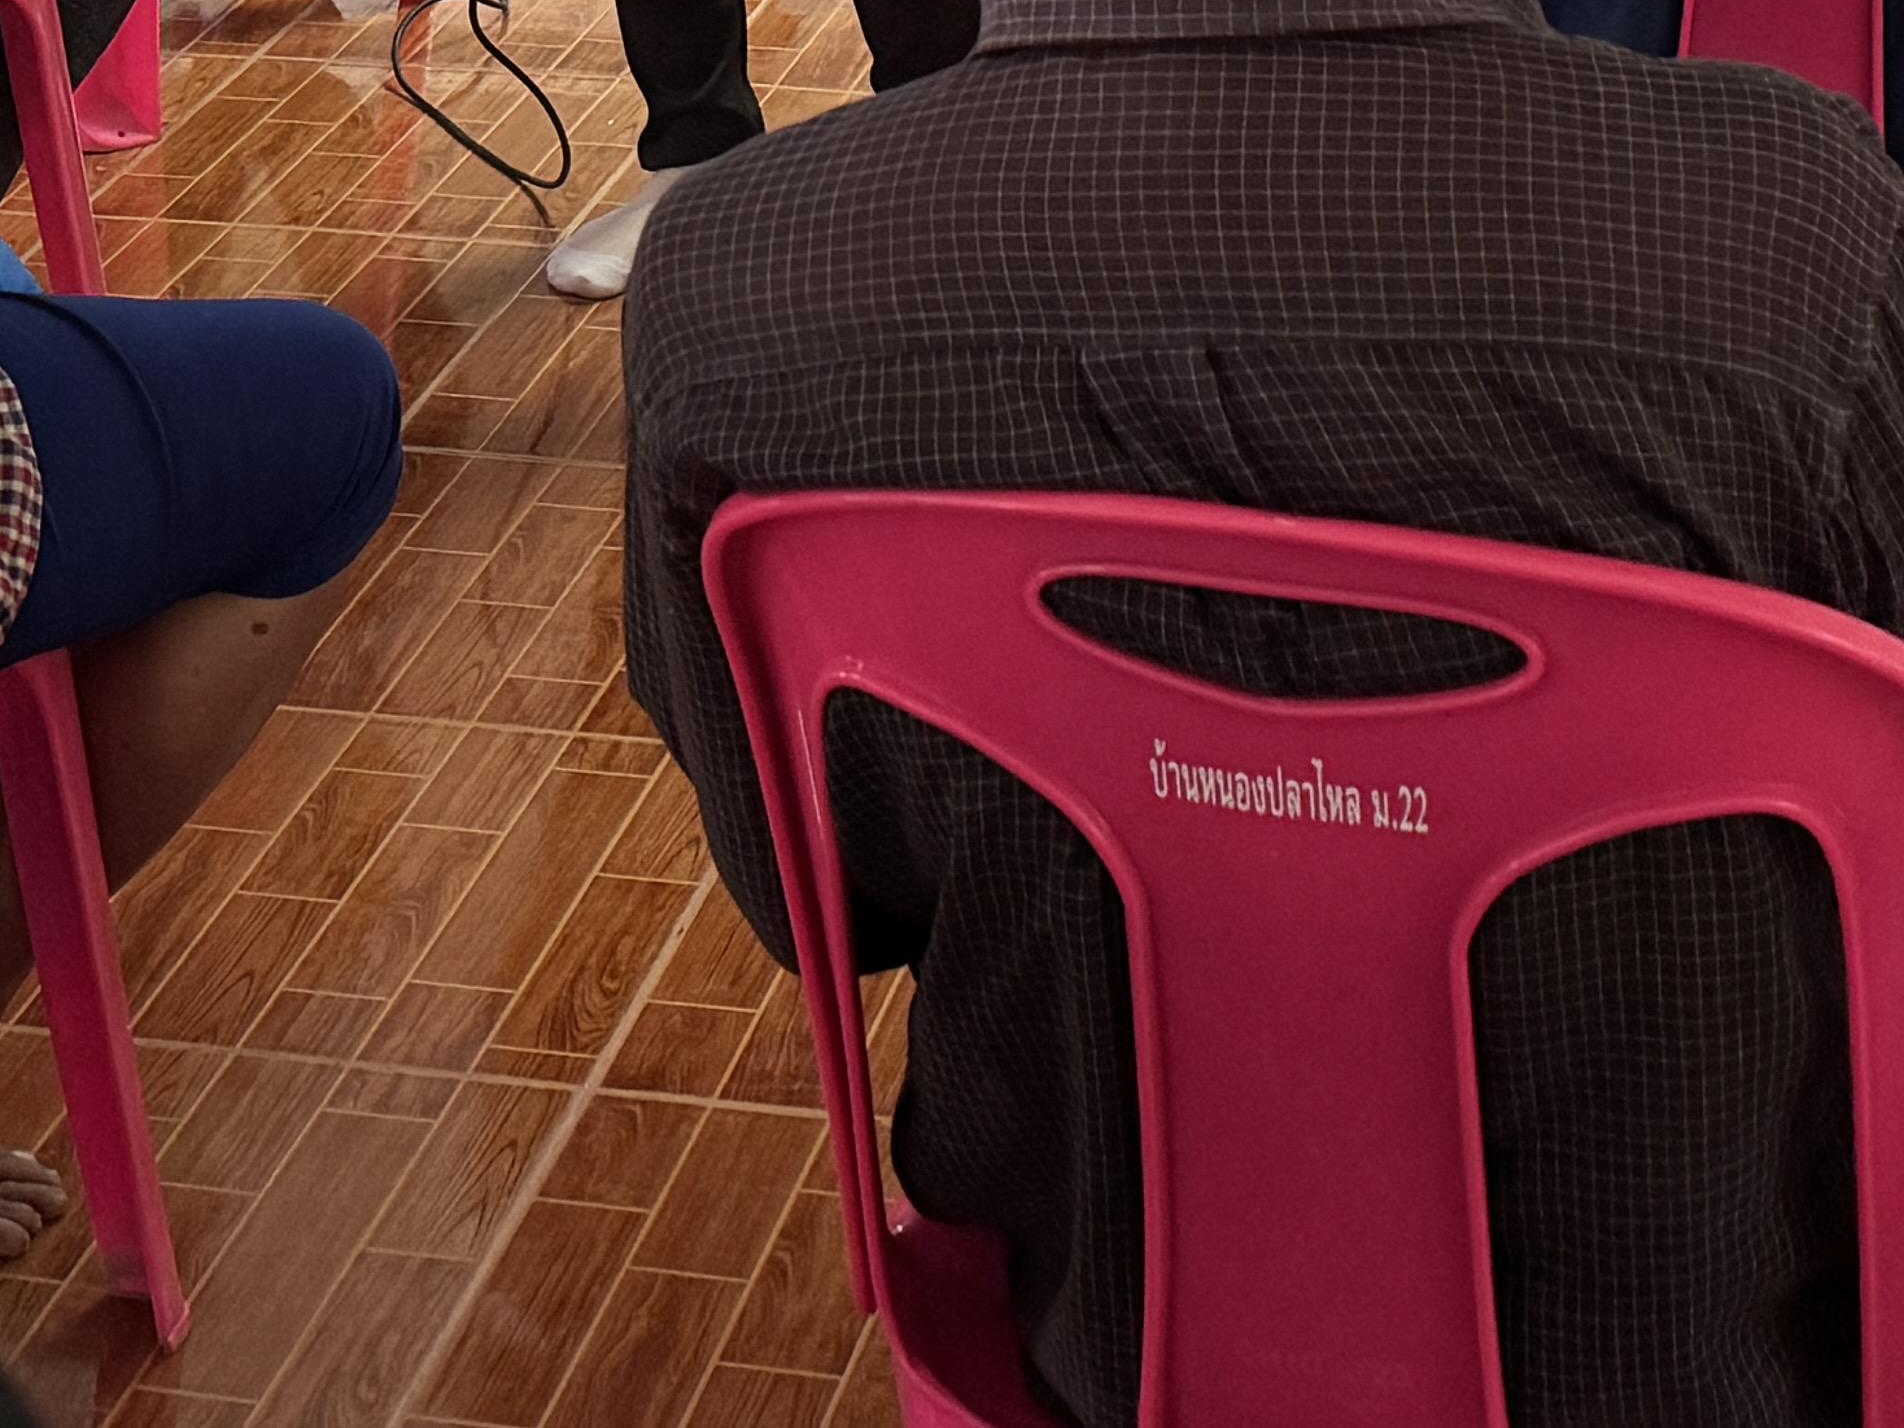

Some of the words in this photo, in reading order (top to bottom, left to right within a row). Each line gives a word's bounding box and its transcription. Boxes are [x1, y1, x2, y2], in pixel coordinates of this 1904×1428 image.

[1149, 738, 1361, 826] บ้านหนองปลาไหล
[1372, 785, 1428, 833] ม.22
